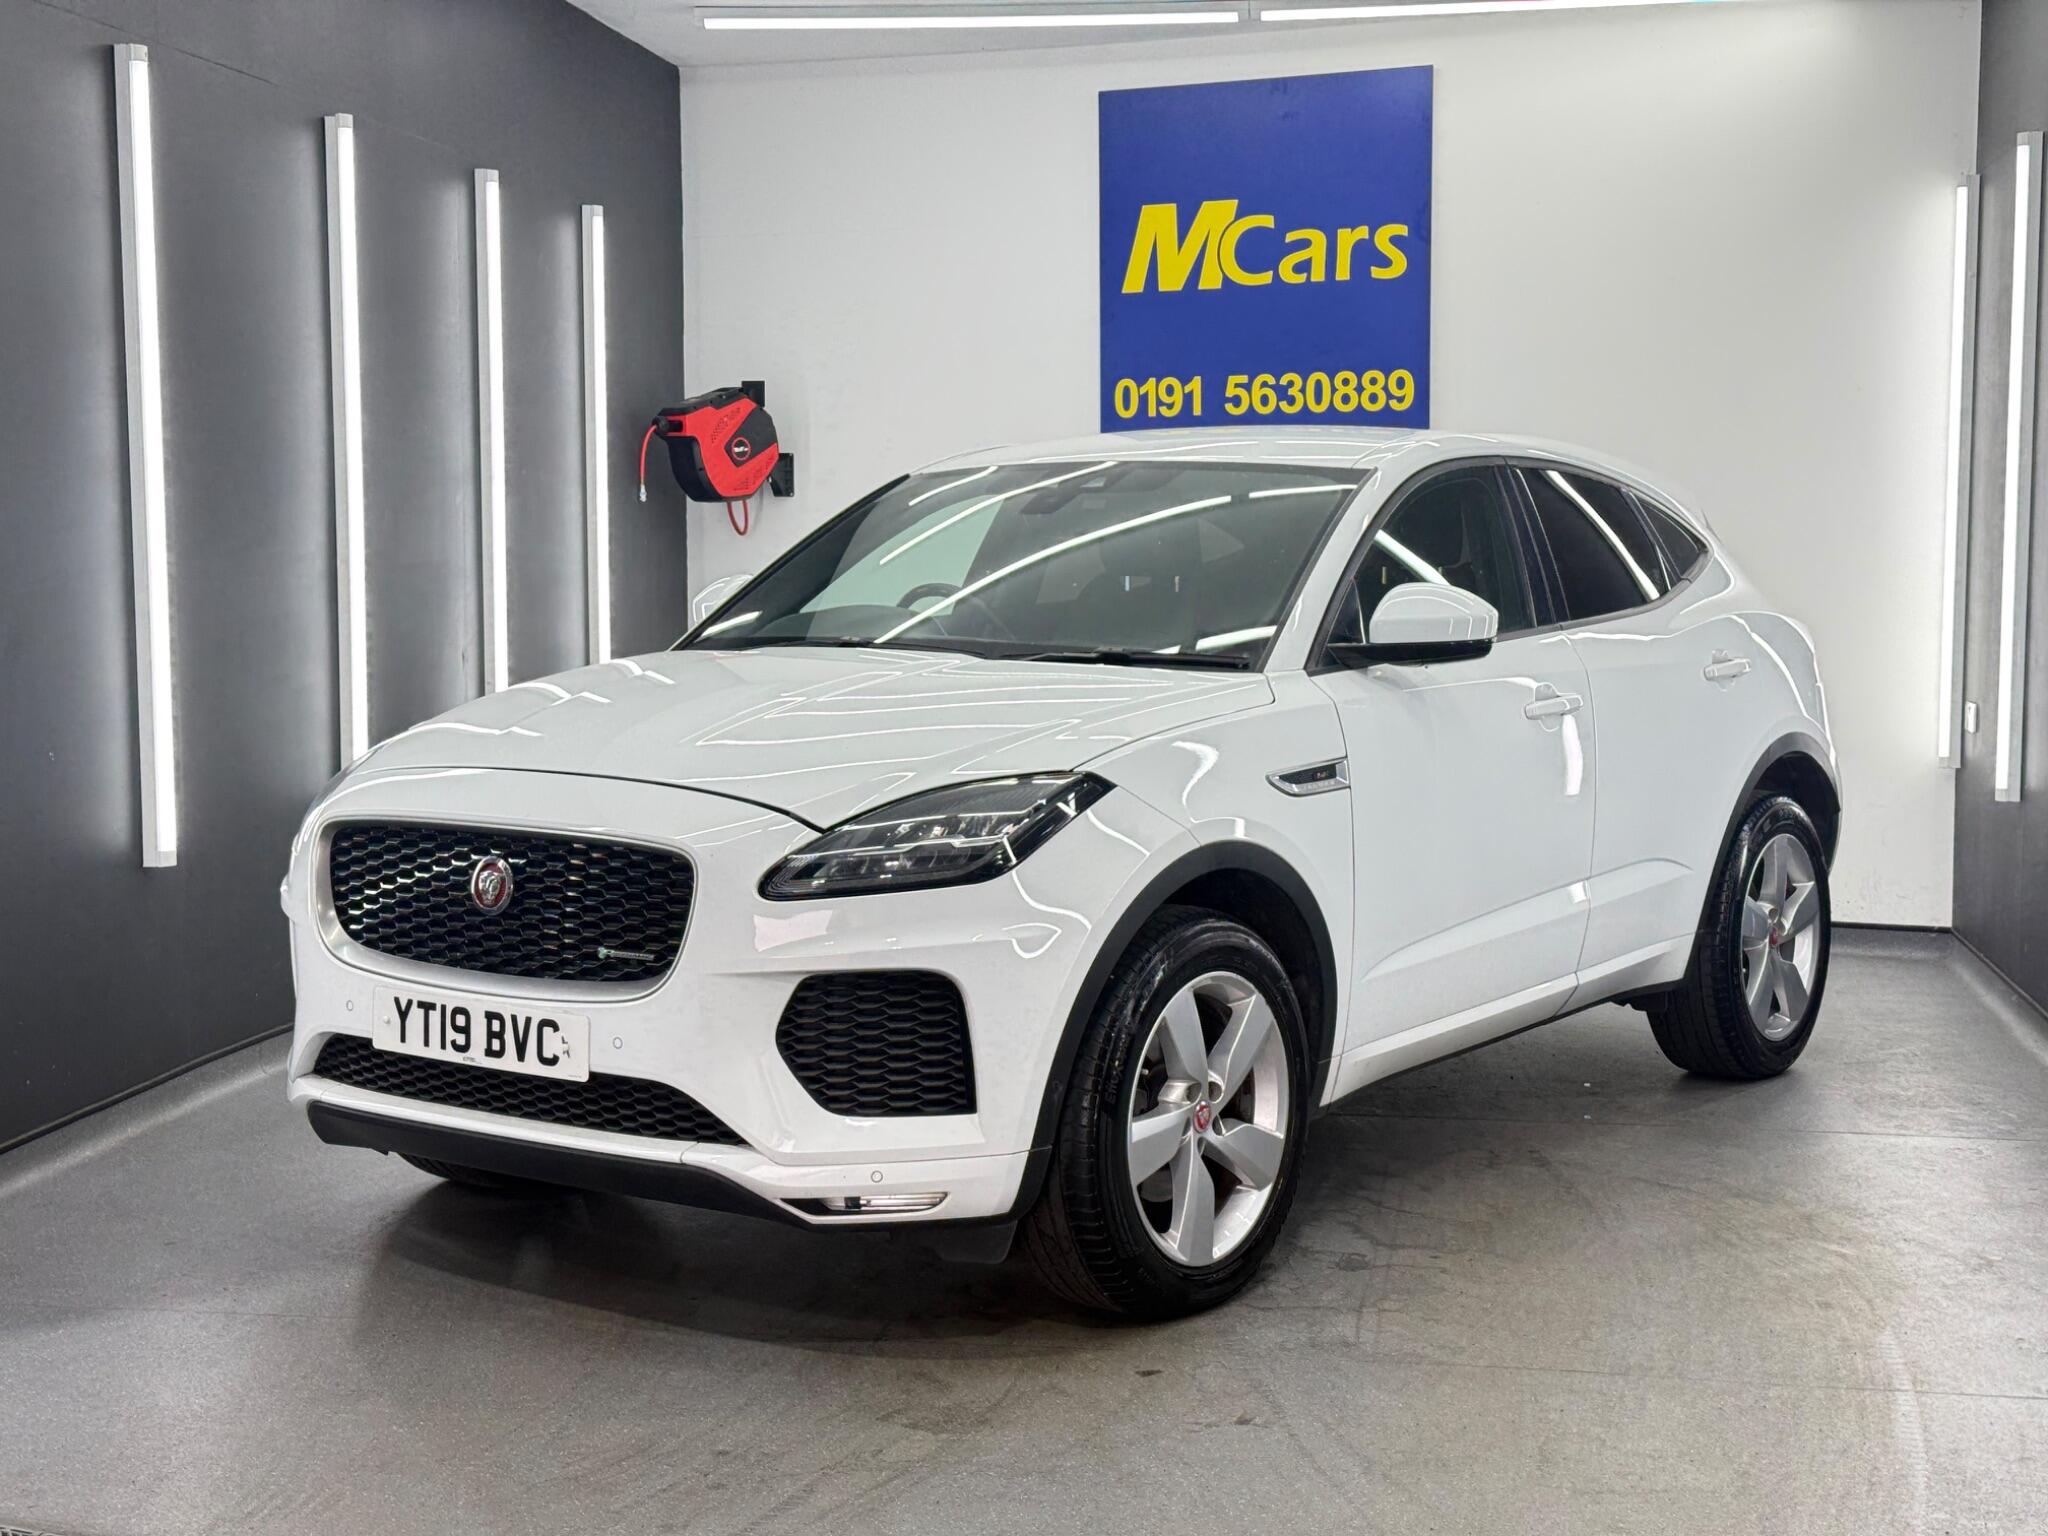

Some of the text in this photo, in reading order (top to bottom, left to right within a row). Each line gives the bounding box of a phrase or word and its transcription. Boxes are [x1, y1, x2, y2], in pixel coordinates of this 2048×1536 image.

[1121, 199, 1409, 295] MCars
[1114, 369, 1415, 419] 0191 5630889
[393, 996, 561, 1068] YT19 BVC
